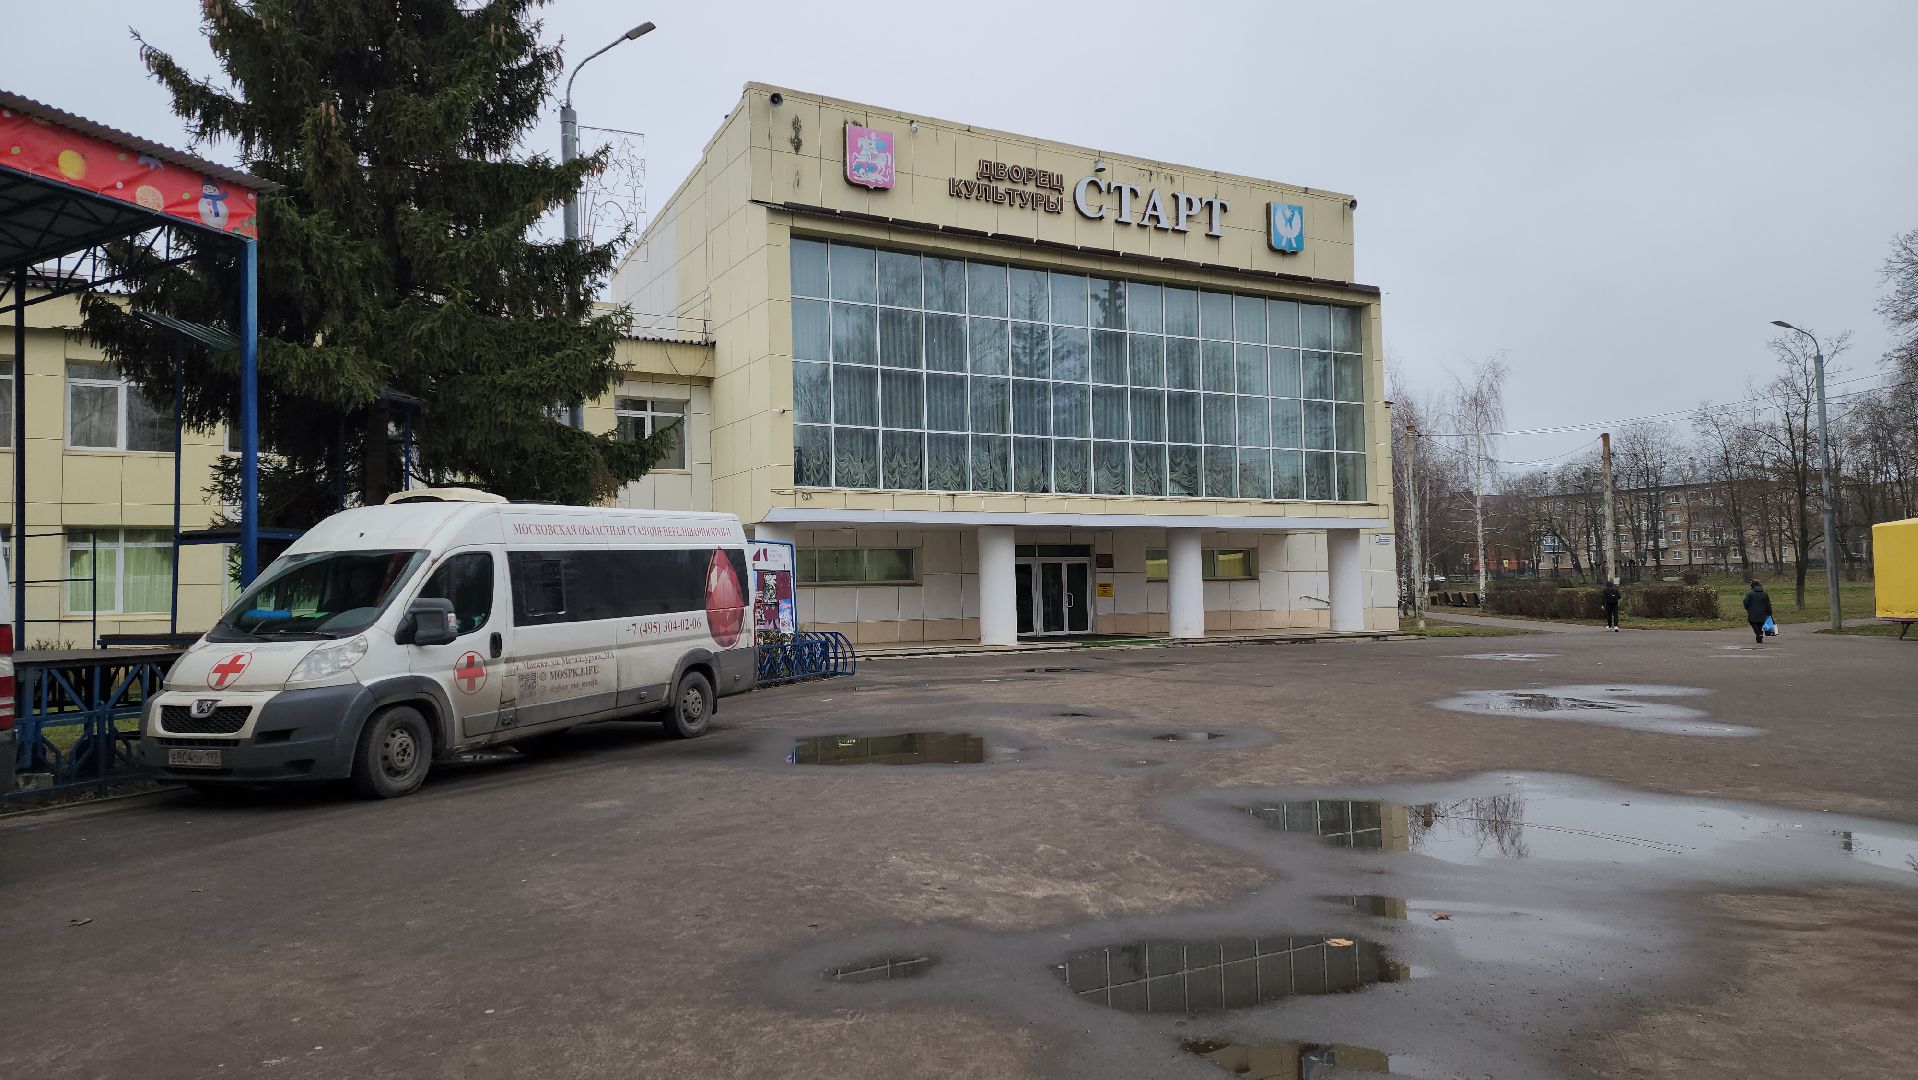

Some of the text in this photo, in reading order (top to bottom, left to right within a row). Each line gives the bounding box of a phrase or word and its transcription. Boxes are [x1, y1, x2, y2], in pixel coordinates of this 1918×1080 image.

[977, 159, 1065, 193] ДВОРЕЦ
[949, 177, 1064, 213] КУЛЬТУРЫ
[1073, 175, 1231, 238] СТАРТ
[513, 523, 577, 536] МОСКОВСКАЯ
[578, 525, 626, 536] ОБЛАСТНАЯ
[627, 526, 661, 537] СТАНЦИЯ
[626, 617, 702, 636] +7 (495) 304-02-06
[549, 665, 599, 681] MOSPK.LIFE
